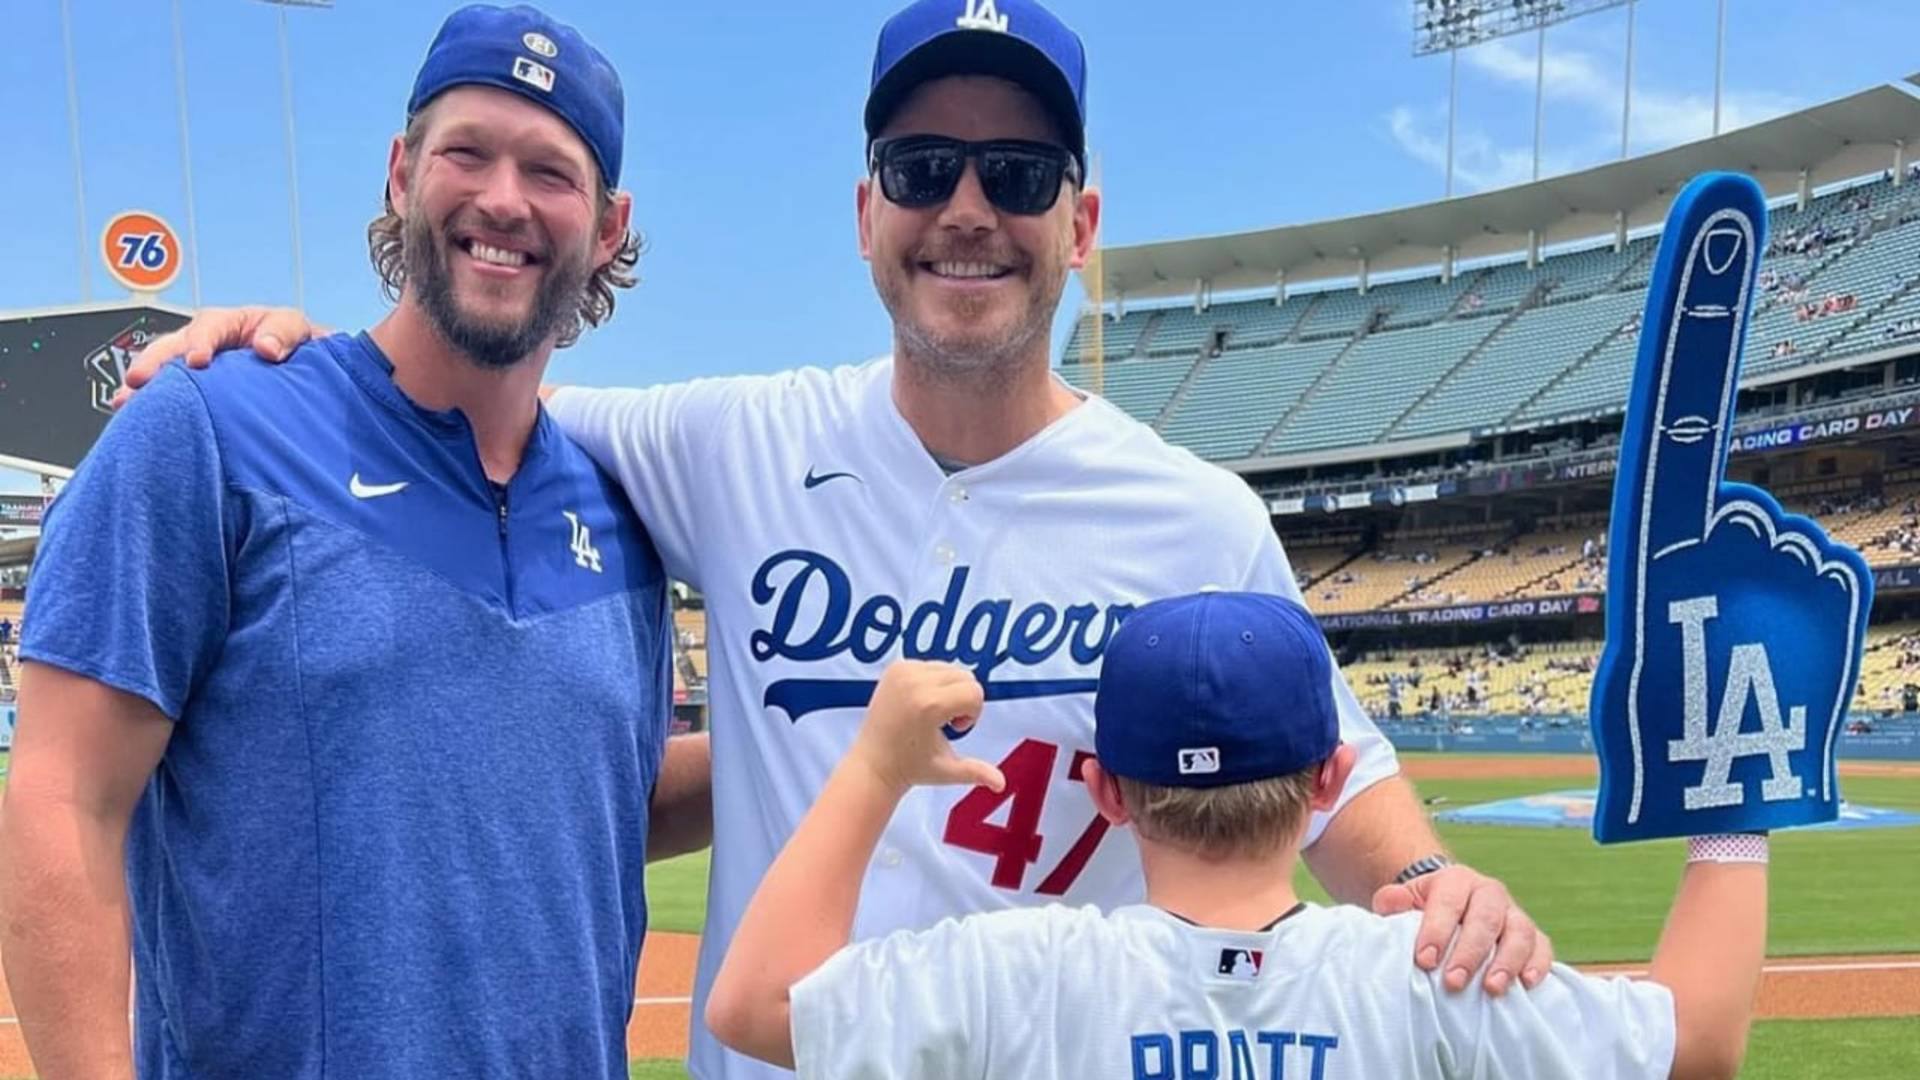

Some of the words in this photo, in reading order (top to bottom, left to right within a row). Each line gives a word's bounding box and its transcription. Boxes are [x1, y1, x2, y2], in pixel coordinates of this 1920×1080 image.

[117, 234, 167, 269] 76
[1729, 429, 1793, 453] ADING
[1798, 417, 1860, 441] CARD
[1865, 408, 1913, 430] DAY
[562, 511, 602, 573] LA
[1408, 606, 1483, 625] TRADING
[1487, 603, 1535, 619] CARD
[1539, 599, 1573, 615] DAY
[1667, 595, 1807, 810] LA
[943, 737, 1111, 896] 47
[1131, 1029, 1339, 1080] PRATT
